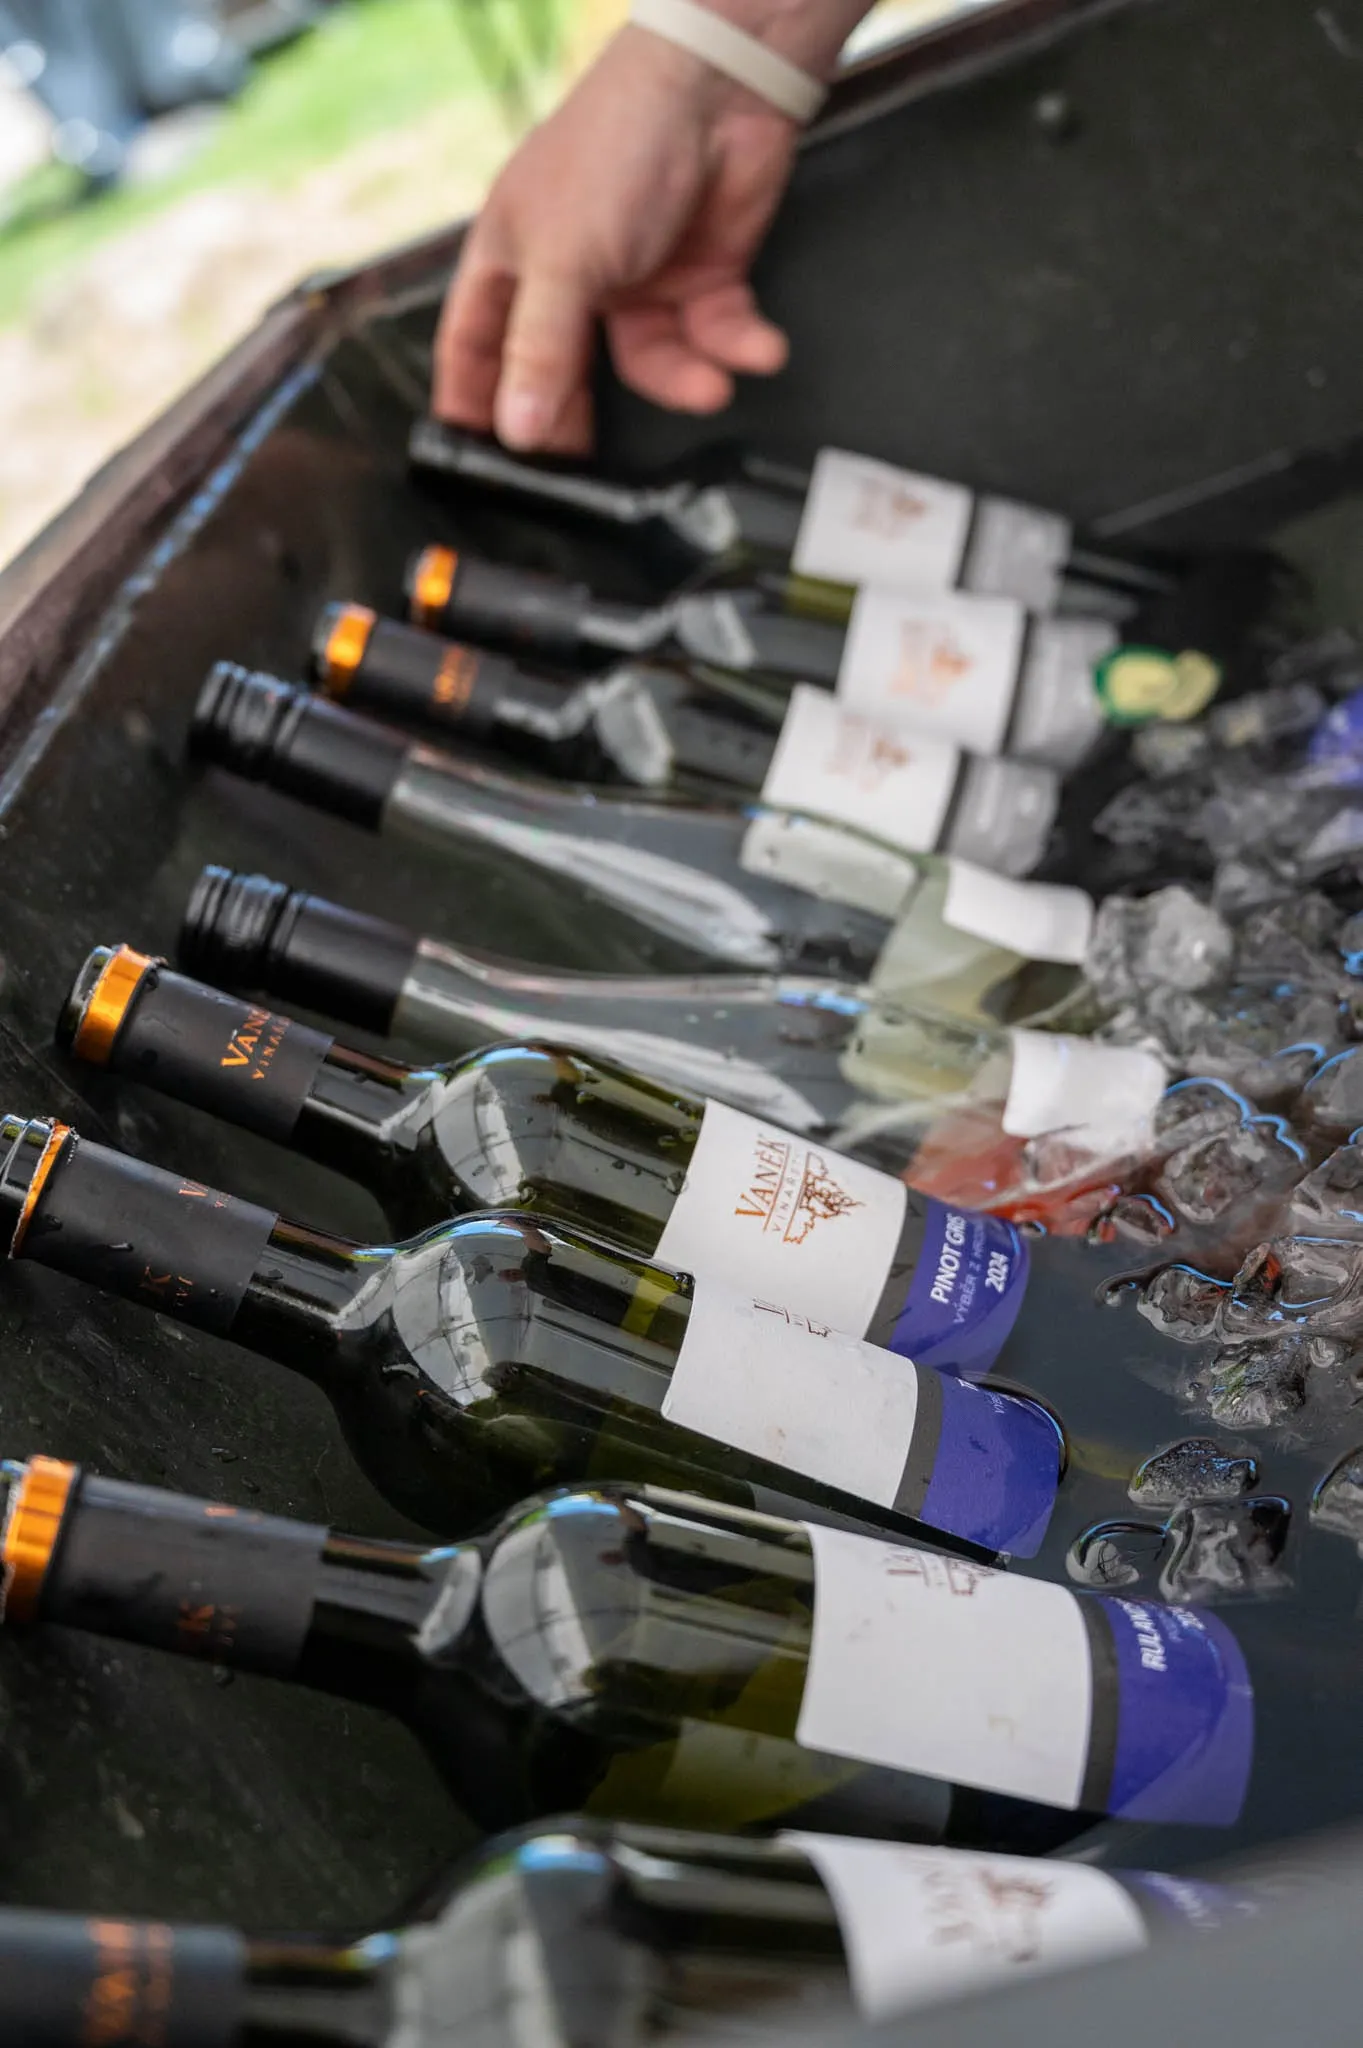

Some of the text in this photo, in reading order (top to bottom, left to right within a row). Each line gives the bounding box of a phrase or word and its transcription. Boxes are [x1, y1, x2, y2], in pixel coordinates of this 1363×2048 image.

[735, 1132, 785, 1217] VANĚK
[930, 1243, 963, 1305] PINOT
[953, 1275, 978, 1324] VÝBĚR
[969, 1260, 982, 1273] Z
[985, 1251, 1010, 1294] 2024
